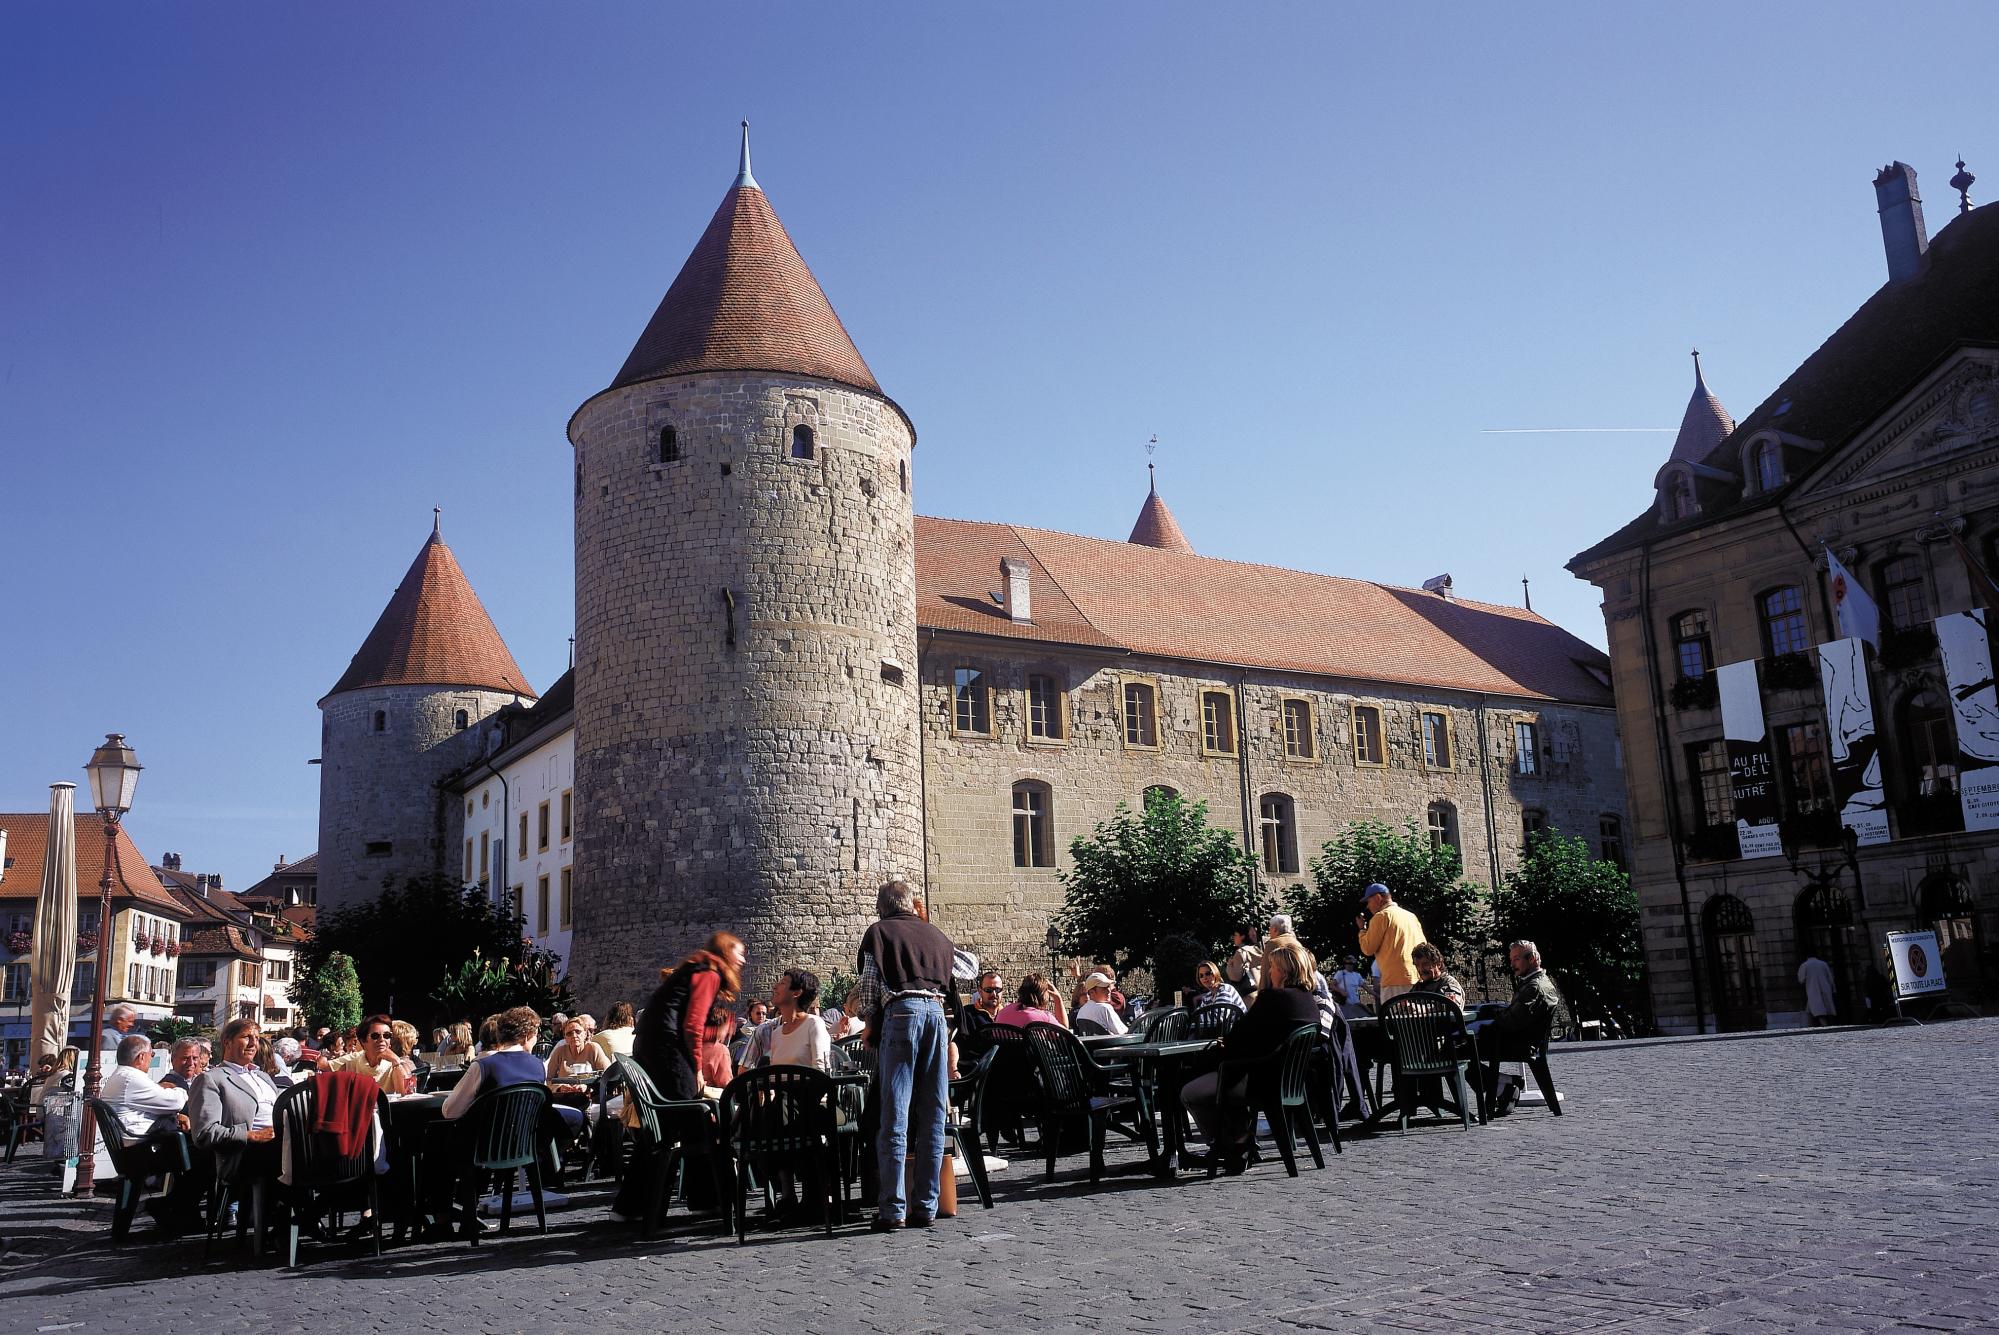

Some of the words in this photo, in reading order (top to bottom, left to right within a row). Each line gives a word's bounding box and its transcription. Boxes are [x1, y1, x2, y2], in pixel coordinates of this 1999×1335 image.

[1734, 756, 1748, 767] AU
[1752, 752, 1770, 765] FIL
[1744, 766, 1758, 777] DE
[1733, 785, 1765, 799] AUTRE
[1900, 982, 1910, 991] SUR
[1910, 980, 1924, 990] TOUTE
[1924, 980, 1930, 988] LA
[1930, 977, 1944, 987] PLACE
